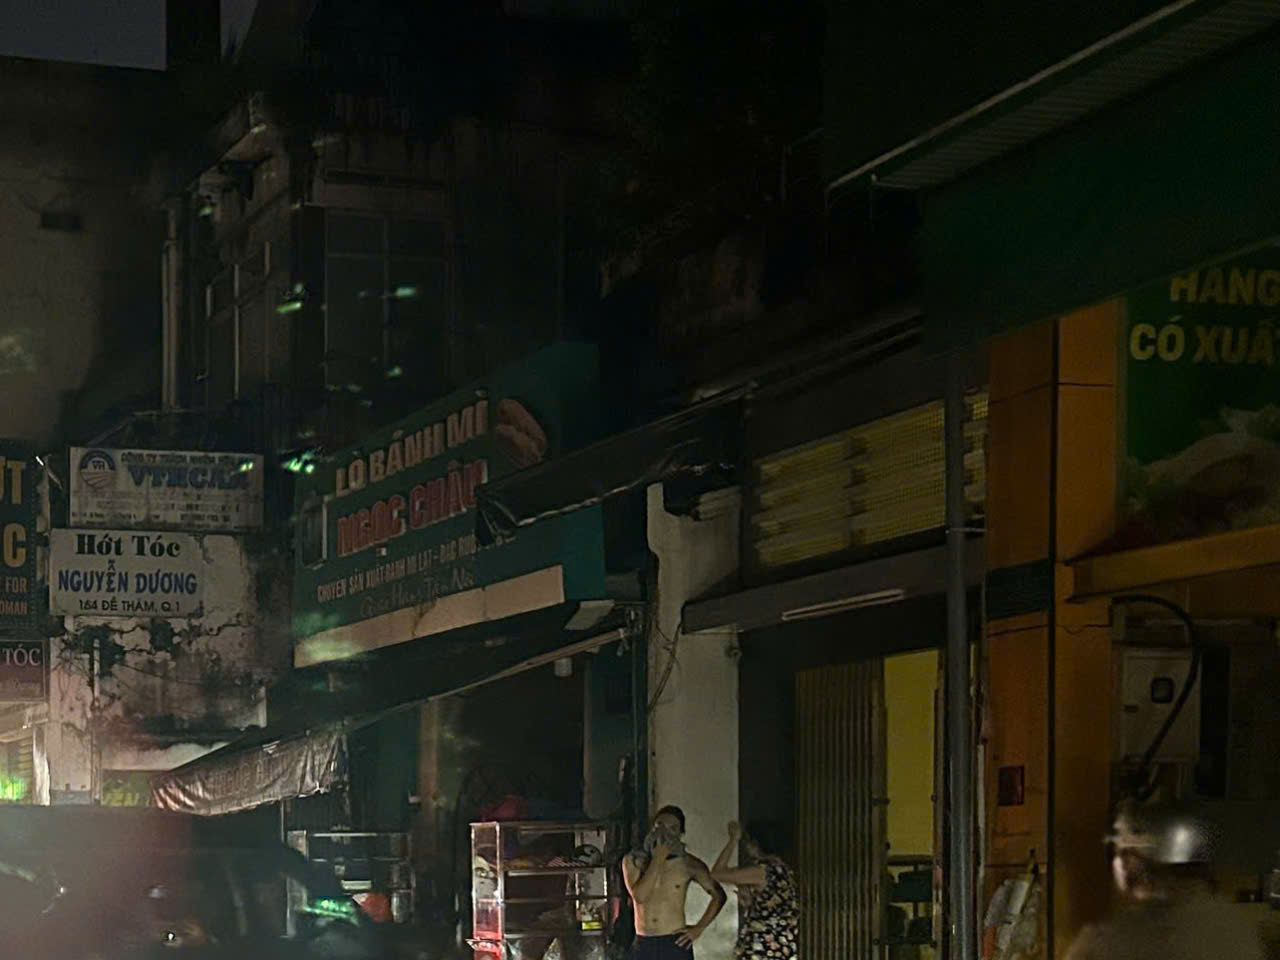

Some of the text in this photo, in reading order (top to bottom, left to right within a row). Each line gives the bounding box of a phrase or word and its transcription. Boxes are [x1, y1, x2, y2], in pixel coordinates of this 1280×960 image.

[1129, 314, 1185, 361] CÓ
[75, 533, 180, 557] Hớt Tóc
[5, 576, 28, 592] FOR
[58, 559, 198, 594] NGUYỄN DƯƠNG
[3, 644, 41, 666] TÓC
